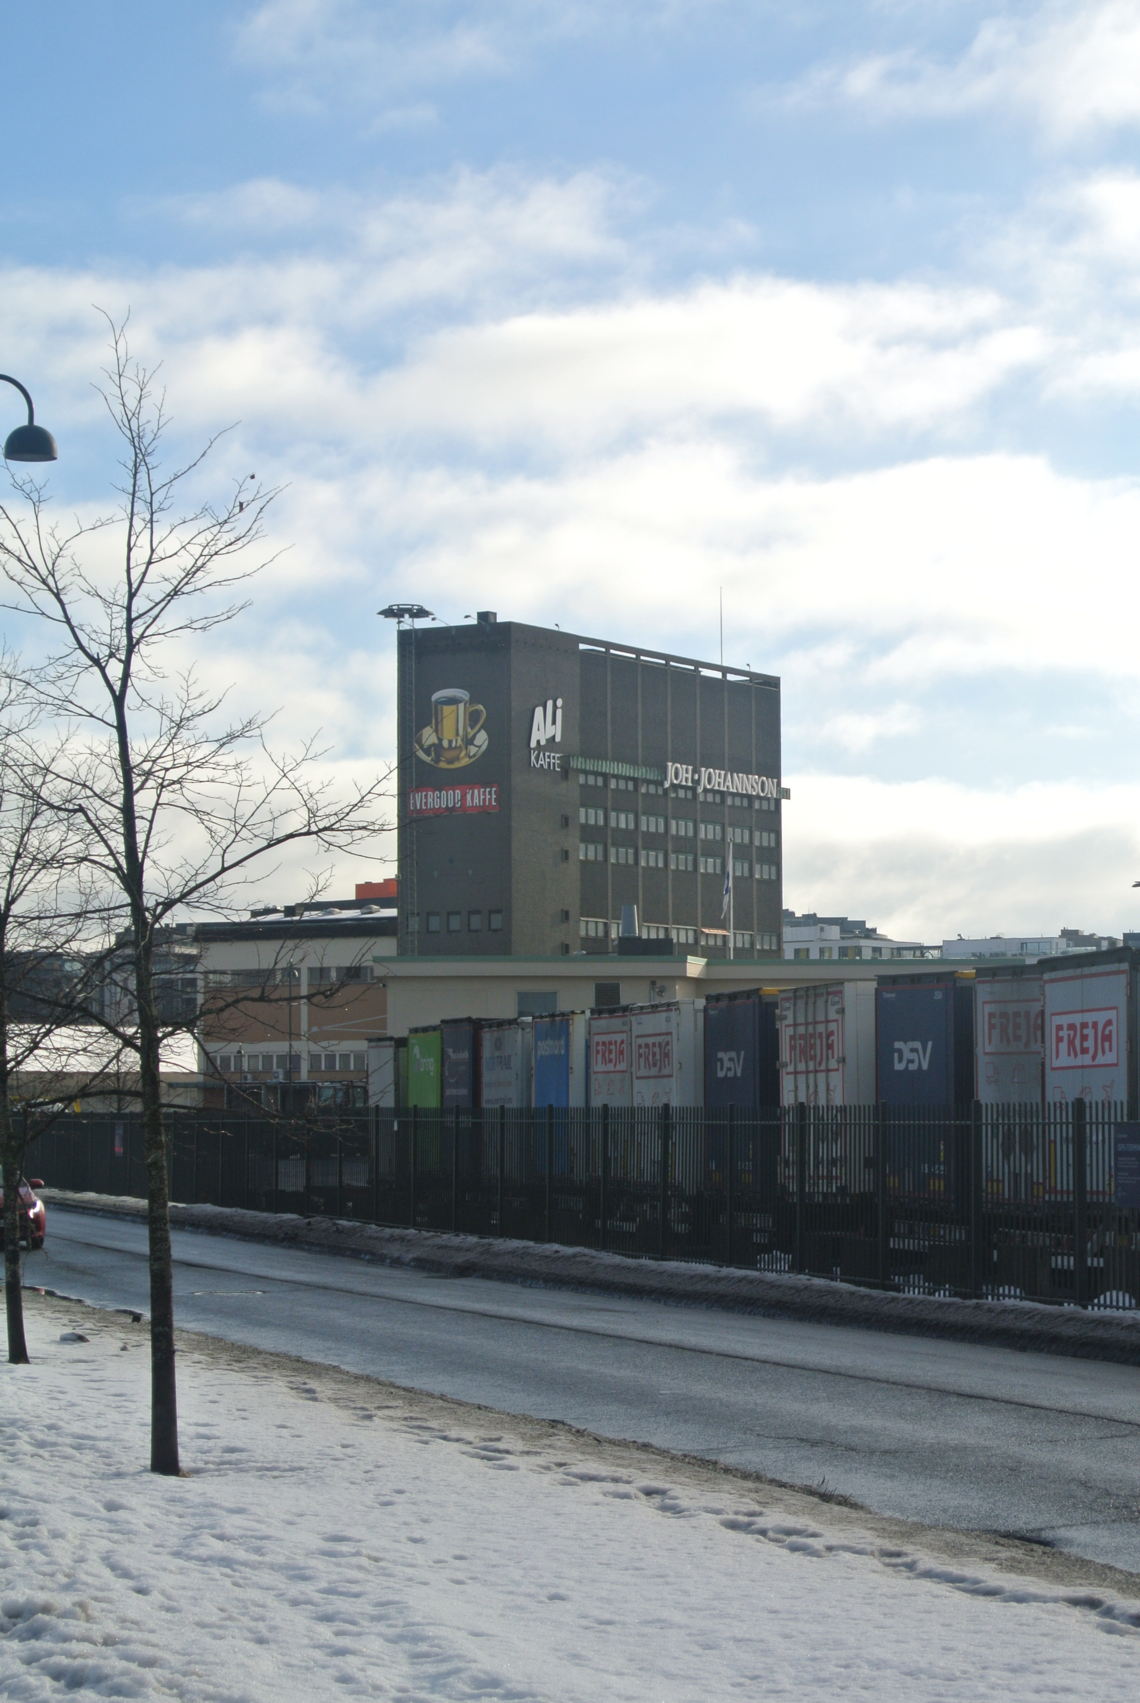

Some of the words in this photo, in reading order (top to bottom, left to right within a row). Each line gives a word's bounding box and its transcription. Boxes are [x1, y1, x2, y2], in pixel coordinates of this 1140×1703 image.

[530, 750, 561, 771] KAFFE
[410, 789, 462, 810] EVERGOOD
[466, 787, 497, 807] KAFFE
[987, 1009, 1042, 1050] FREJA
[1055, 1018, 1114, 1063] FREJA
[537, 1036, 566, 1059] postnord
[595, 1039, 625, 1069] FREJA
[637, 1040, 670, 1074] FREJA
[789, 1030, 835, 1068] FREJA
[894, 1041, 933, 1071] DSV
[420, 1055, 435, 1076] bring
[717, 1051, 745, 1078] DSV
